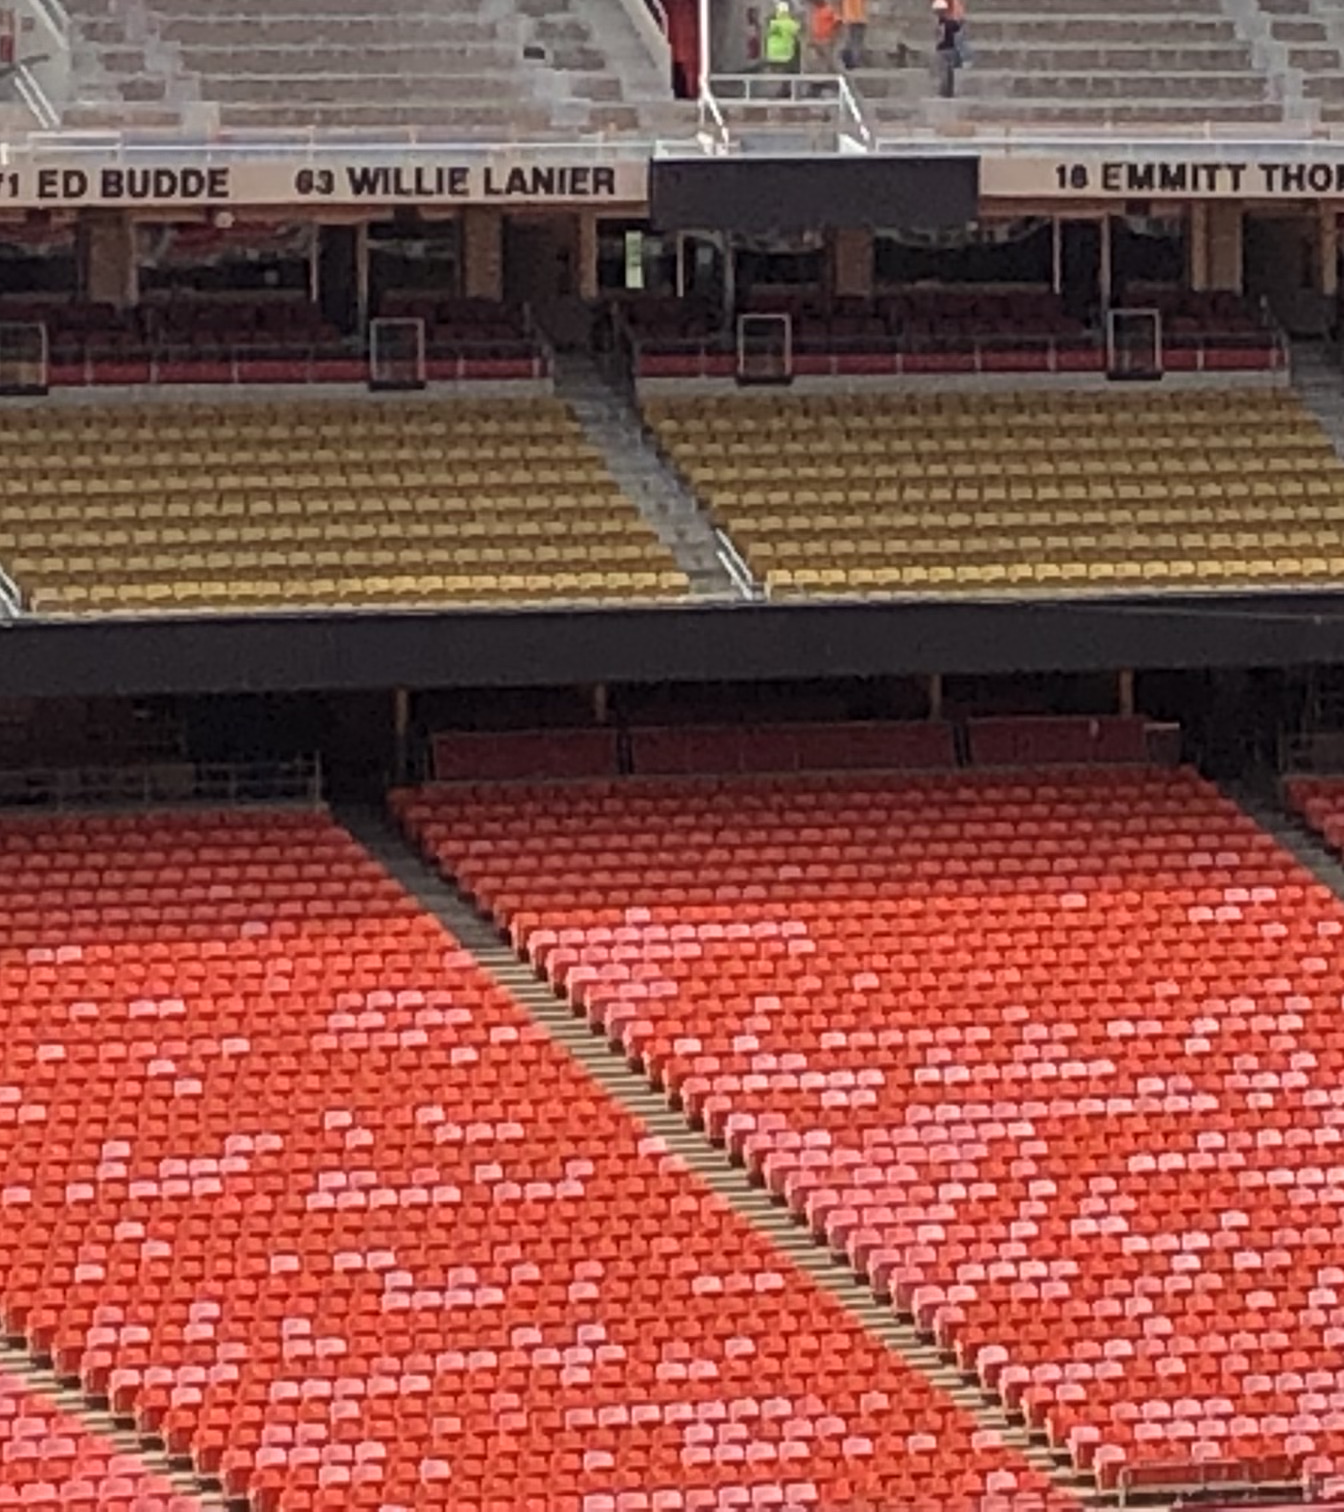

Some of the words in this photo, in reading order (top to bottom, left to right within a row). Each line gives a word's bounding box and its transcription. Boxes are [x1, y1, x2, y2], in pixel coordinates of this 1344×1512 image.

[36, 169, 88, 199] ED
[100, 168, 230, 198] BUDDE
[347, 167, 470, 196] WILLIE
[484, 166, 616, 196] LANIER
[1101, 162, 1246, 191] EMMITT
